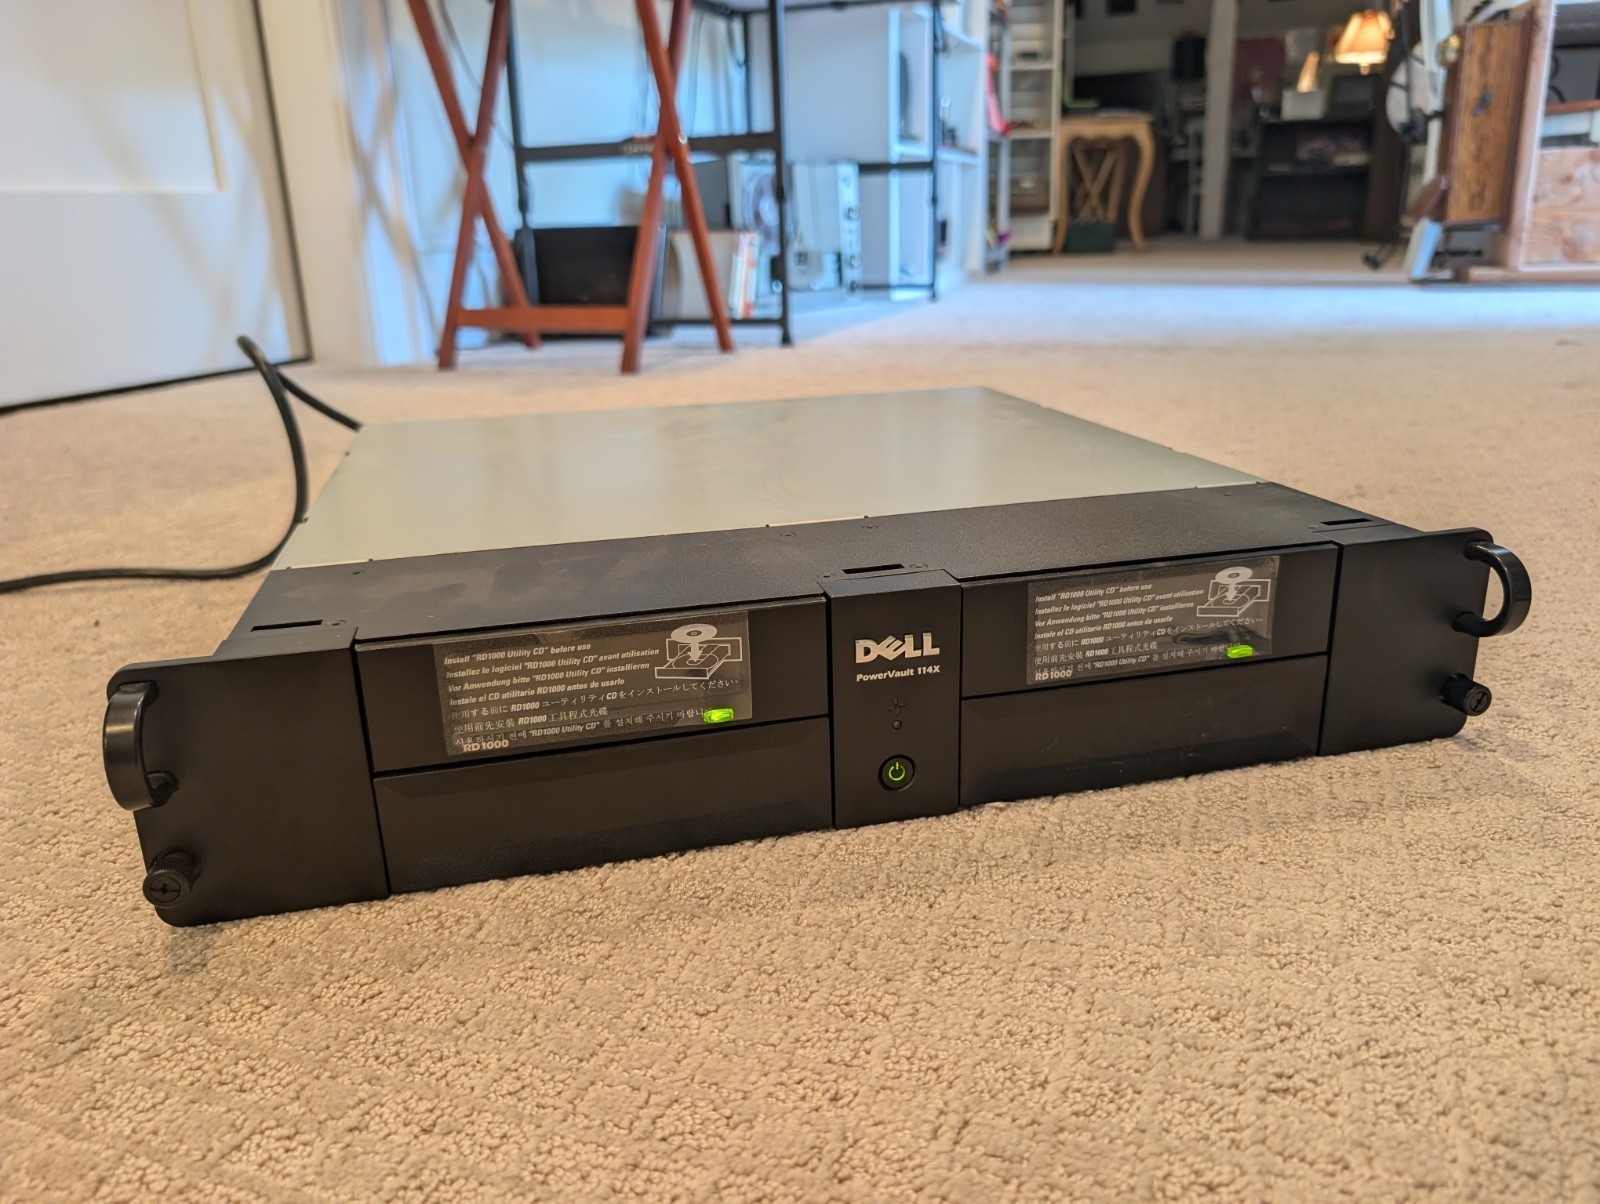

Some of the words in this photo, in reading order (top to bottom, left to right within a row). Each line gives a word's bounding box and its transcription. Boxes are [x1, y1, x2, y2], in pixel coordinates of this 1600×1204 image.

[1035, 593, 1056, 602] Install
[1085, 588, 1104, 596] Utility
[1120, 585, 1139, 593] before
[1035, 606, 1062, 615] Installez
[1071, 602, 1096, 611] logiciel
[1123, 596, 1142, 605] Utility
[1173, 589, 1204, 598] utilisation
[1047, 616, 1084, 626] Anwendung
[1128, 607, 1146, 615] Utility
[1160, 602, 1194, 611] installieren
[1034, 631, 1056, 640] Instale
[1075, 624, 1101, 634] utilitario
[1103, 621, 1125, 630] RD1000
[855, 632, 940, 663] DELL
[1081, 636, 1104, 645] RD1000
[444, 653, 470, 665] Install
[507, 649, 531, 658] Utility
[533, 646, 549, 655] CD"
[551, 645, 576, 654] before
[577, 643, 591, 651] use
[1085, 648, 1109, 658] RD1000
[1118, 657, 1137, 665] Utility
[446, 668, 480, 679] Installez
[492, 663, 522, 674] logiciel
[557, 657, 581, 666] Utility
[583, 654, 598, 664] CD"
[599, 652, 620, 661] avant
[621, 648, 659, 659] utilisation
[448, 684, 461, 692] Vor
[463, 678, 511, 690] Anwendung
[513, 676, 530, 684] bitte
[566, 669, 589, 678] Utility
[591, 666, 605, 675] CD"
[607, 662, 650, 673] installieren
[856, 668, 914, 682] PowerVault
[917, 665, 941, 675] 114X
[1035, 669, 1072, 680] RD1000
[450, 695, 476, 706] Instale
[488, 692, 499, 700] CD
[502, 689, 535, 699] utilitario
[537, 685, 566, 695] RD1000
[567, 683, 588, 691] antes
[589, 681, 599, 689] de
[601, 678, 625, 687] usarlo
[511, 701, 540, 712] RD1000
[518, 714, 547, 725] RD1000
[561, 724, 584, 733] Utility
[585, 721, 600, 730] CD"
[463, 739, 509, 752] RD1000
